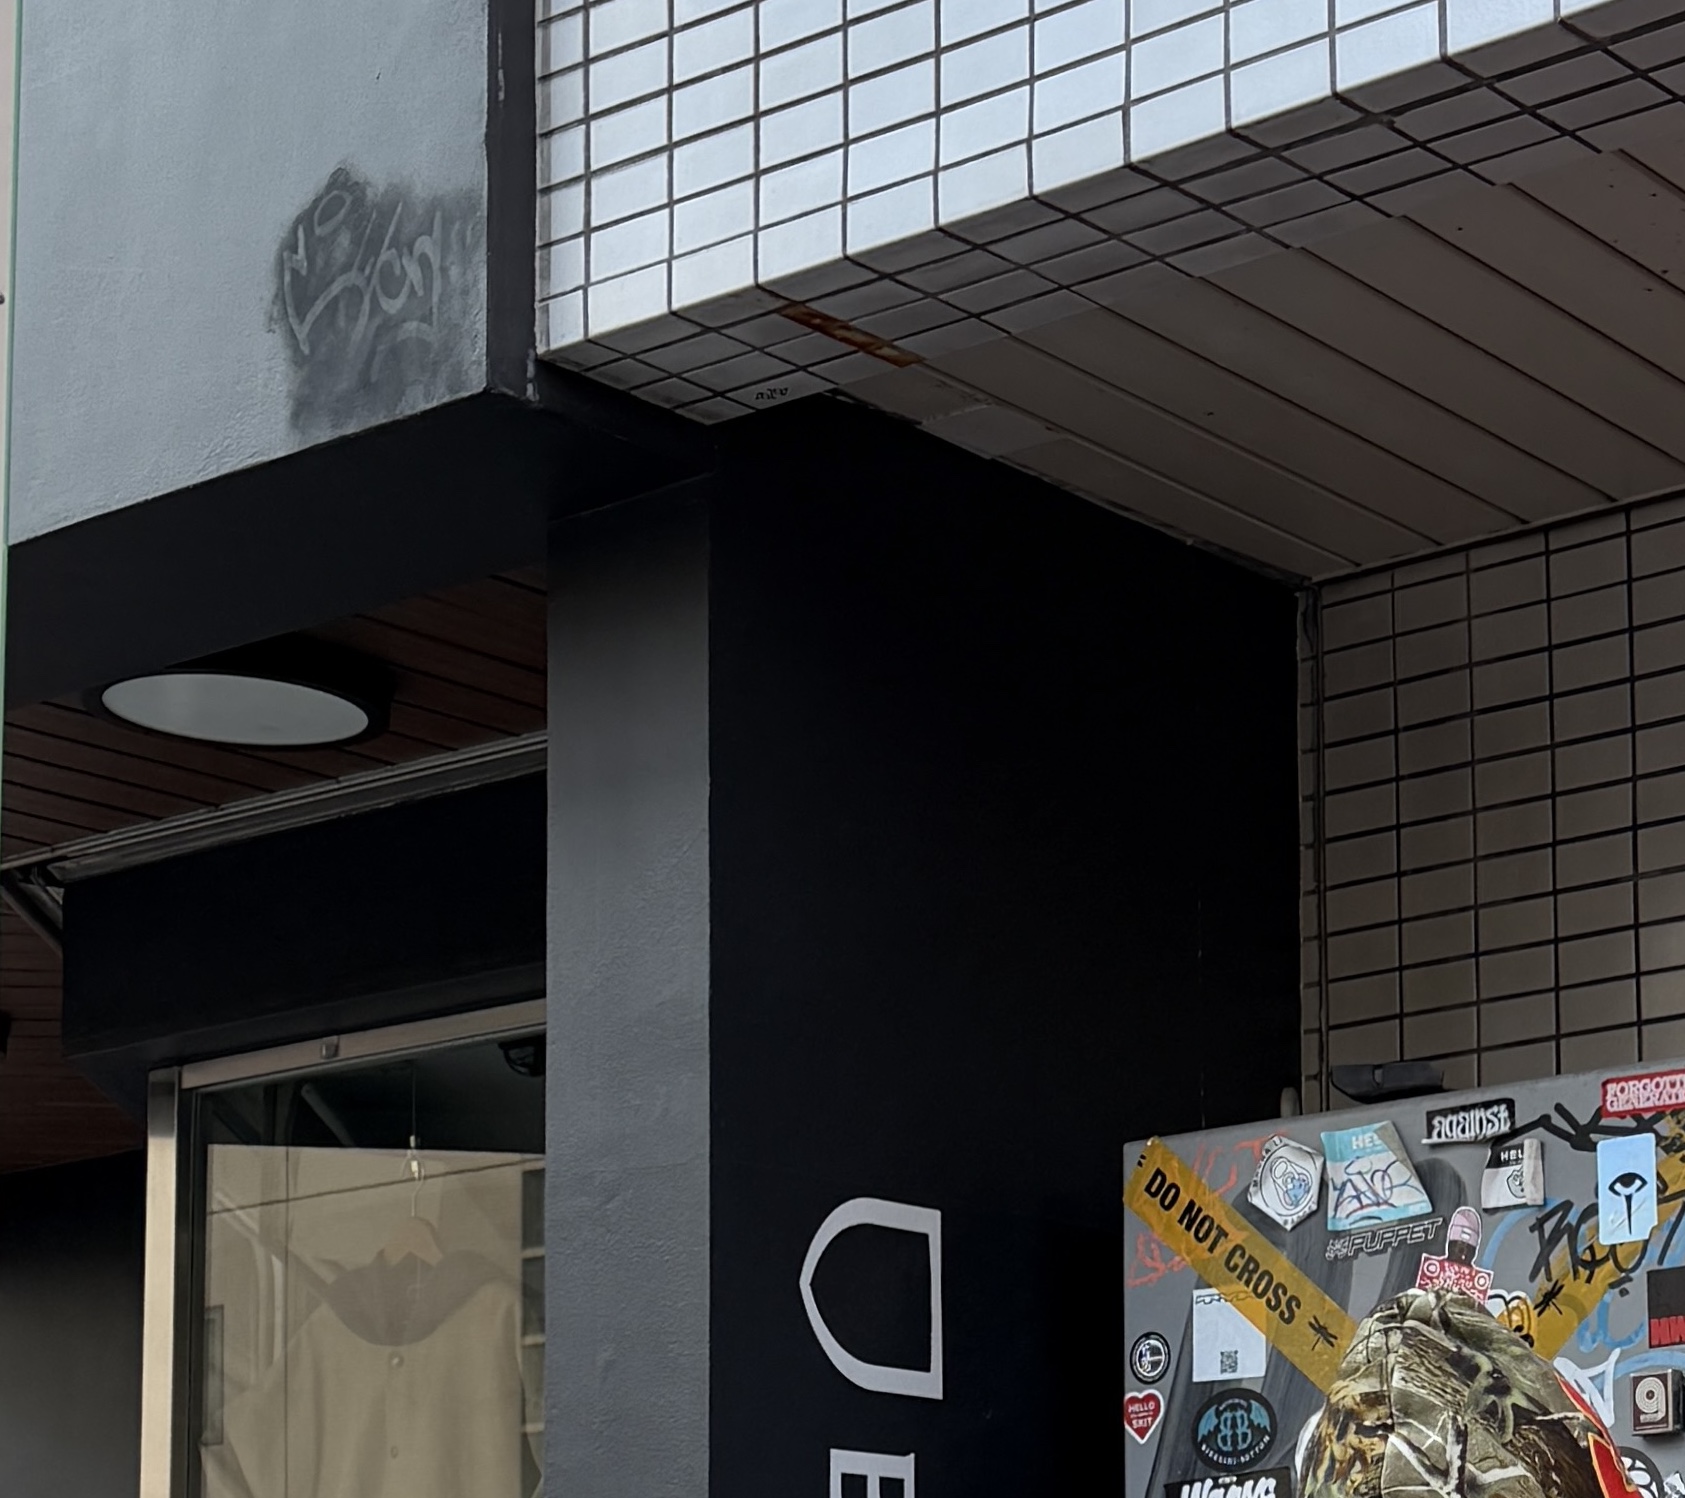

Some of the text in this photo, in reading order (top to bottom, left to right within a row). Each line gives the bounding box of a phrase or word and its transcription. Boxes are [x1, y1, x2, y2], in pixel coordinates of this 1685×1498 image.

[1145, 1166, 1302, 1327] DO NOT CROSS
